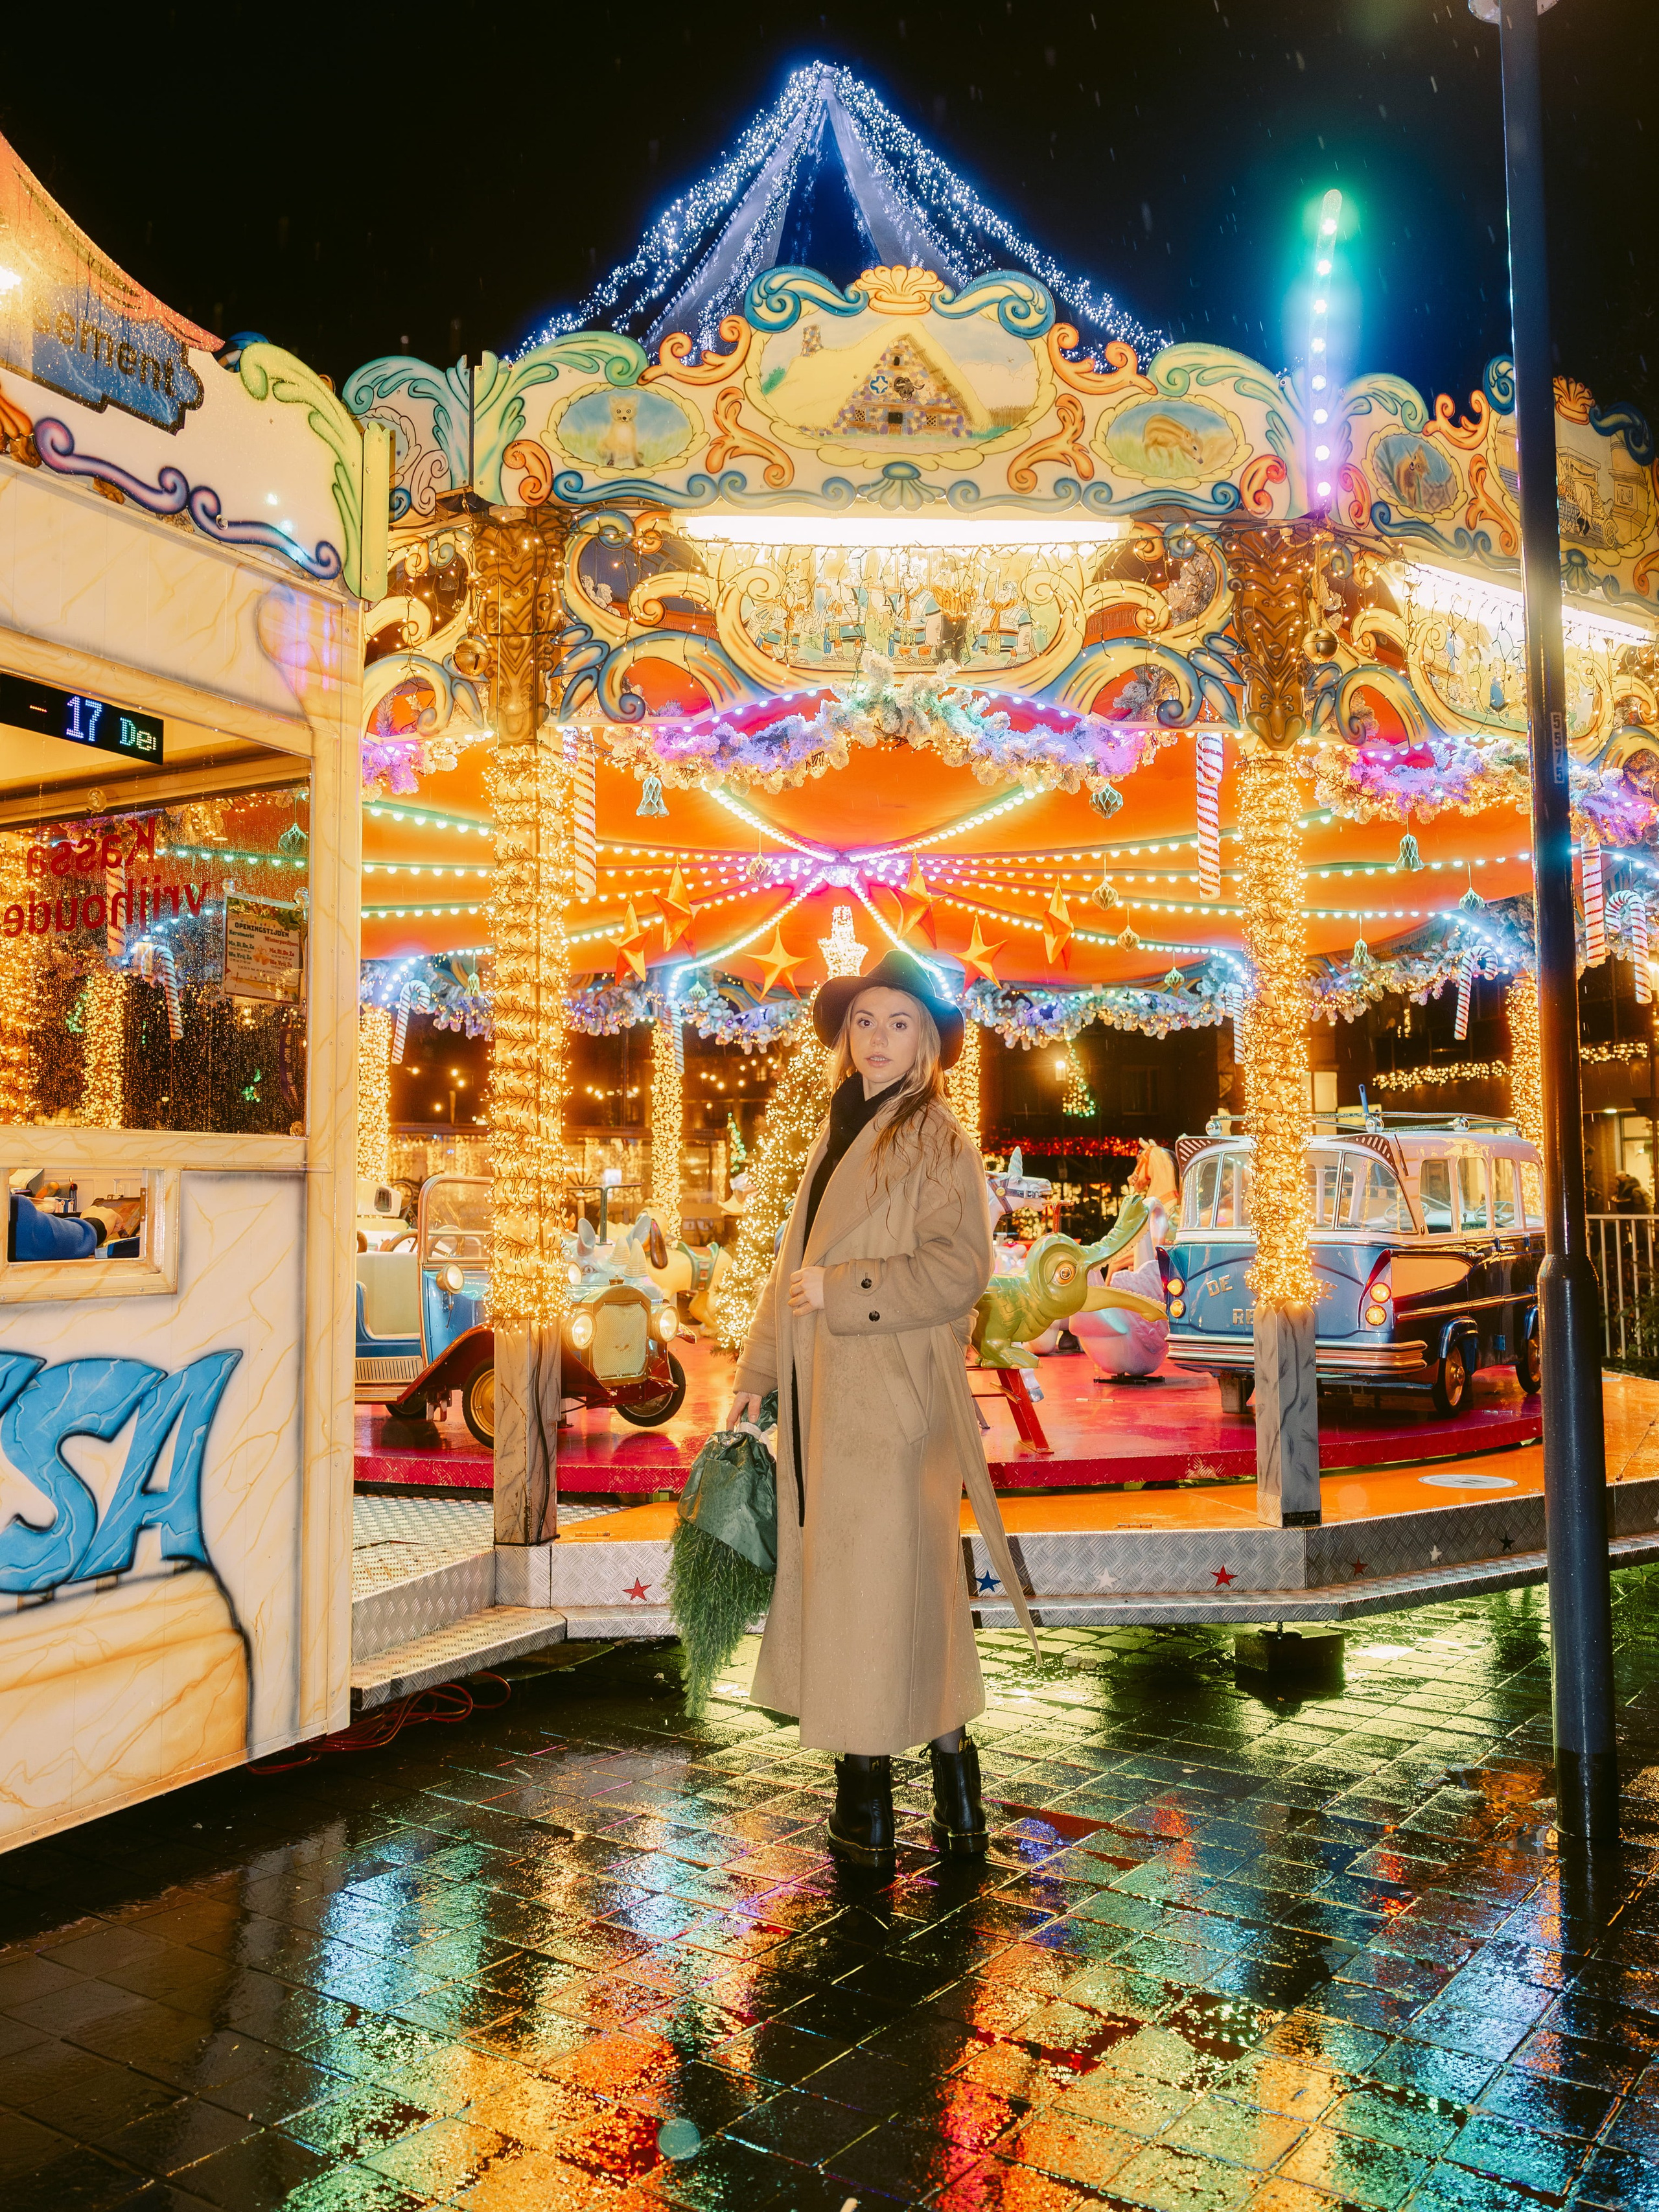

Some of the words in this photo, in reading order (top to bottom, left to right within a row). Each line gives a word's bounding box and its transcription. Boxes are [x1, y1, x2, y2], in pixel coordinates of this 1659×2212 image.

[32, 295, 176, 398] sement
[67, 695, 102, 741] 17
[120, 717, 156, 751] De
[1553, 714, 1564, 782] 5575
[235, 922, 289, 938] OPENINGSTIJDEN
[1206, 1274, 1233, 1297] DE
[1232, 1308, 1255, 1325] RE
[0, 1349, 243, 1595] SA
